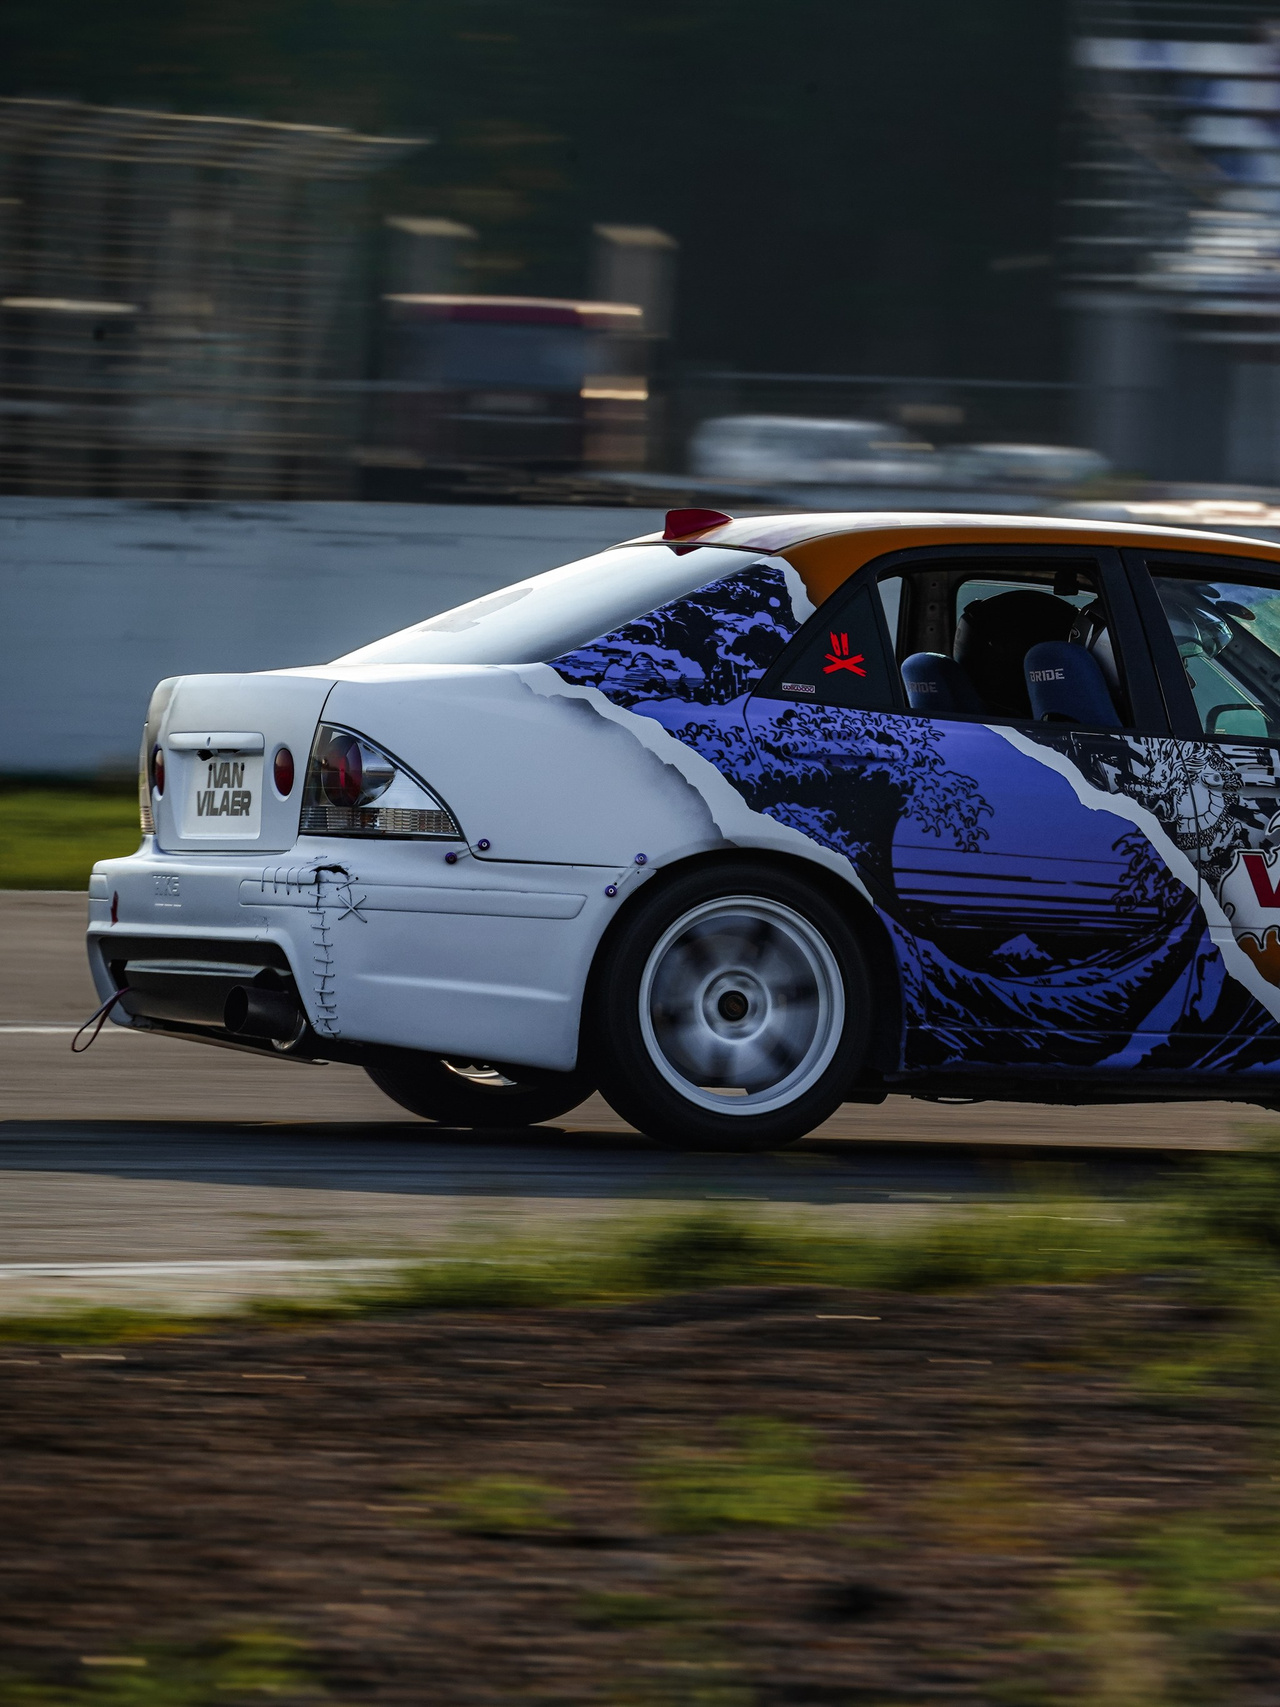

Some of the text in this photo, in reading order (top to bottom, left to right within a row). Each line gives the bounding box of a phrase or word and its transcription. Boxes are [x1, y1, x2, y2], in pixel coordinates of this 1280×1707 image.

[1030, 668, 1065, 682] BRIDE
[207, 762, 245, 789] IVAN
[197, 790, 252, 817] VILAER
